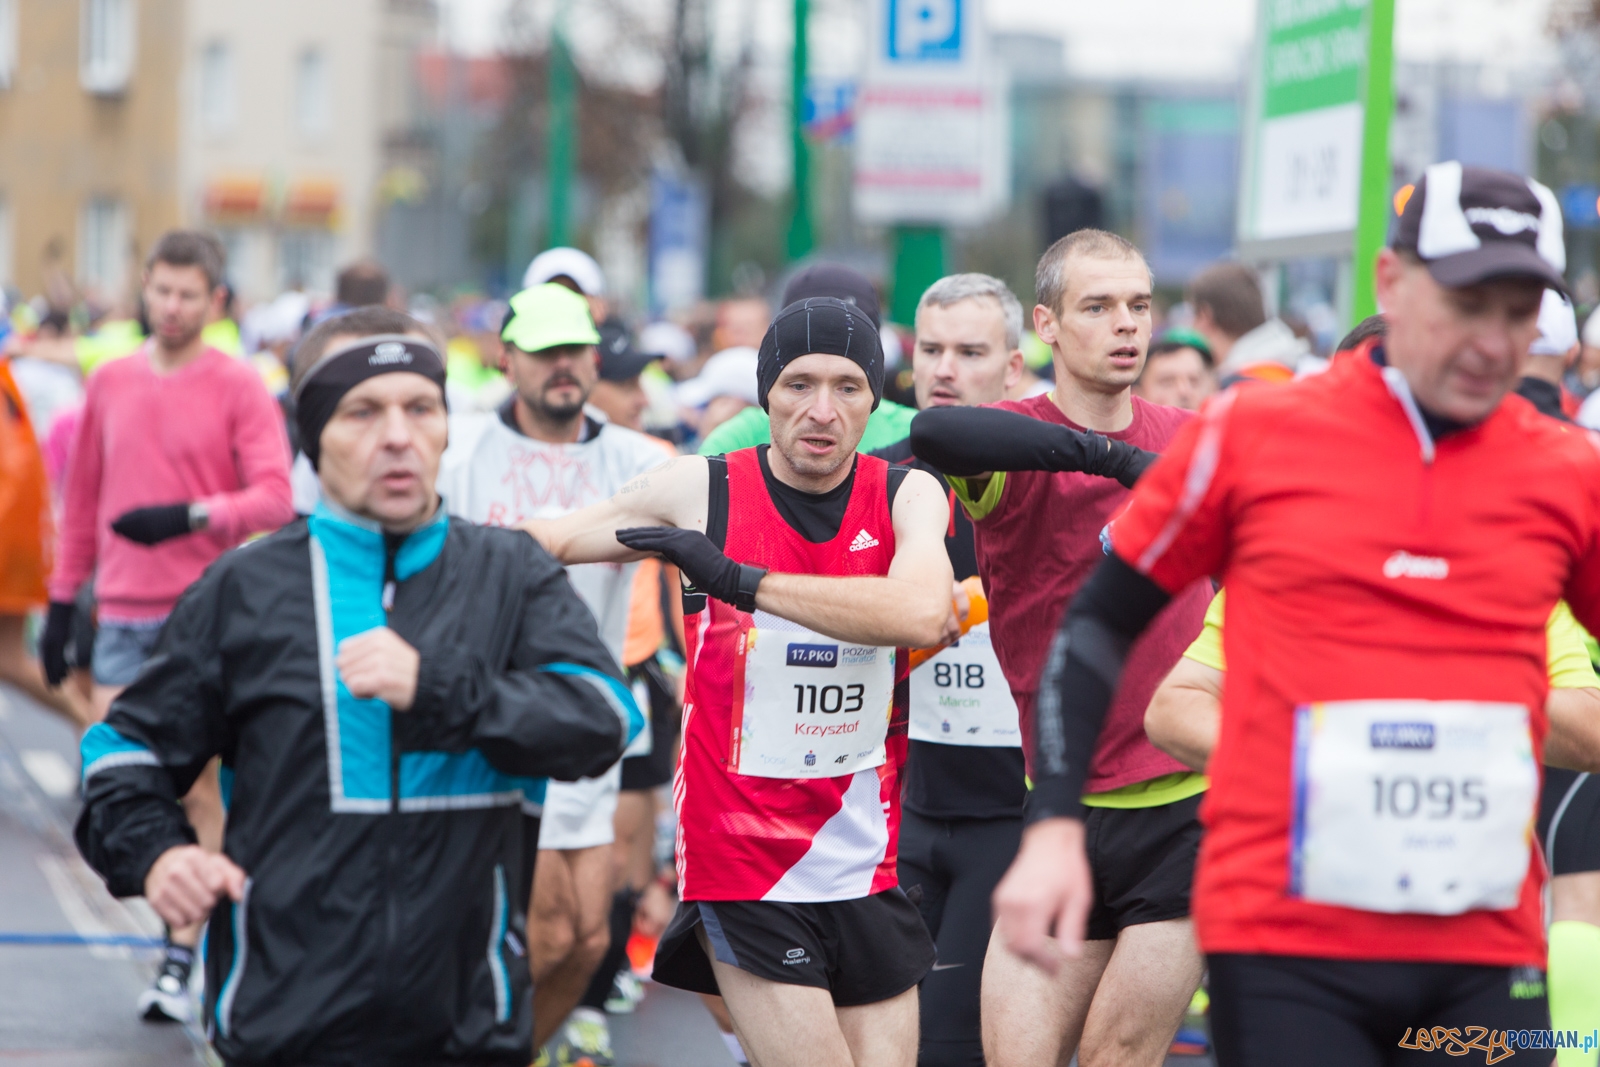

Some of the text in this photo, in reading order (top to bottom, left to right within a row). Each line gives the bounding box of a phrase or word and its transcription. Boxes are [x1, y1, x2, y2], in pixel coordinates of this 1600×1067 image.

[849, 539, 879, 551] adidas
[934, 662, 984, 689] 818
[794, 683, 865, 714] 1103
[939, 695, 980, 708] Marcin
[795, 720, 860, 738] Krzysztof
[1371, 775, 1489, 821] 1095
